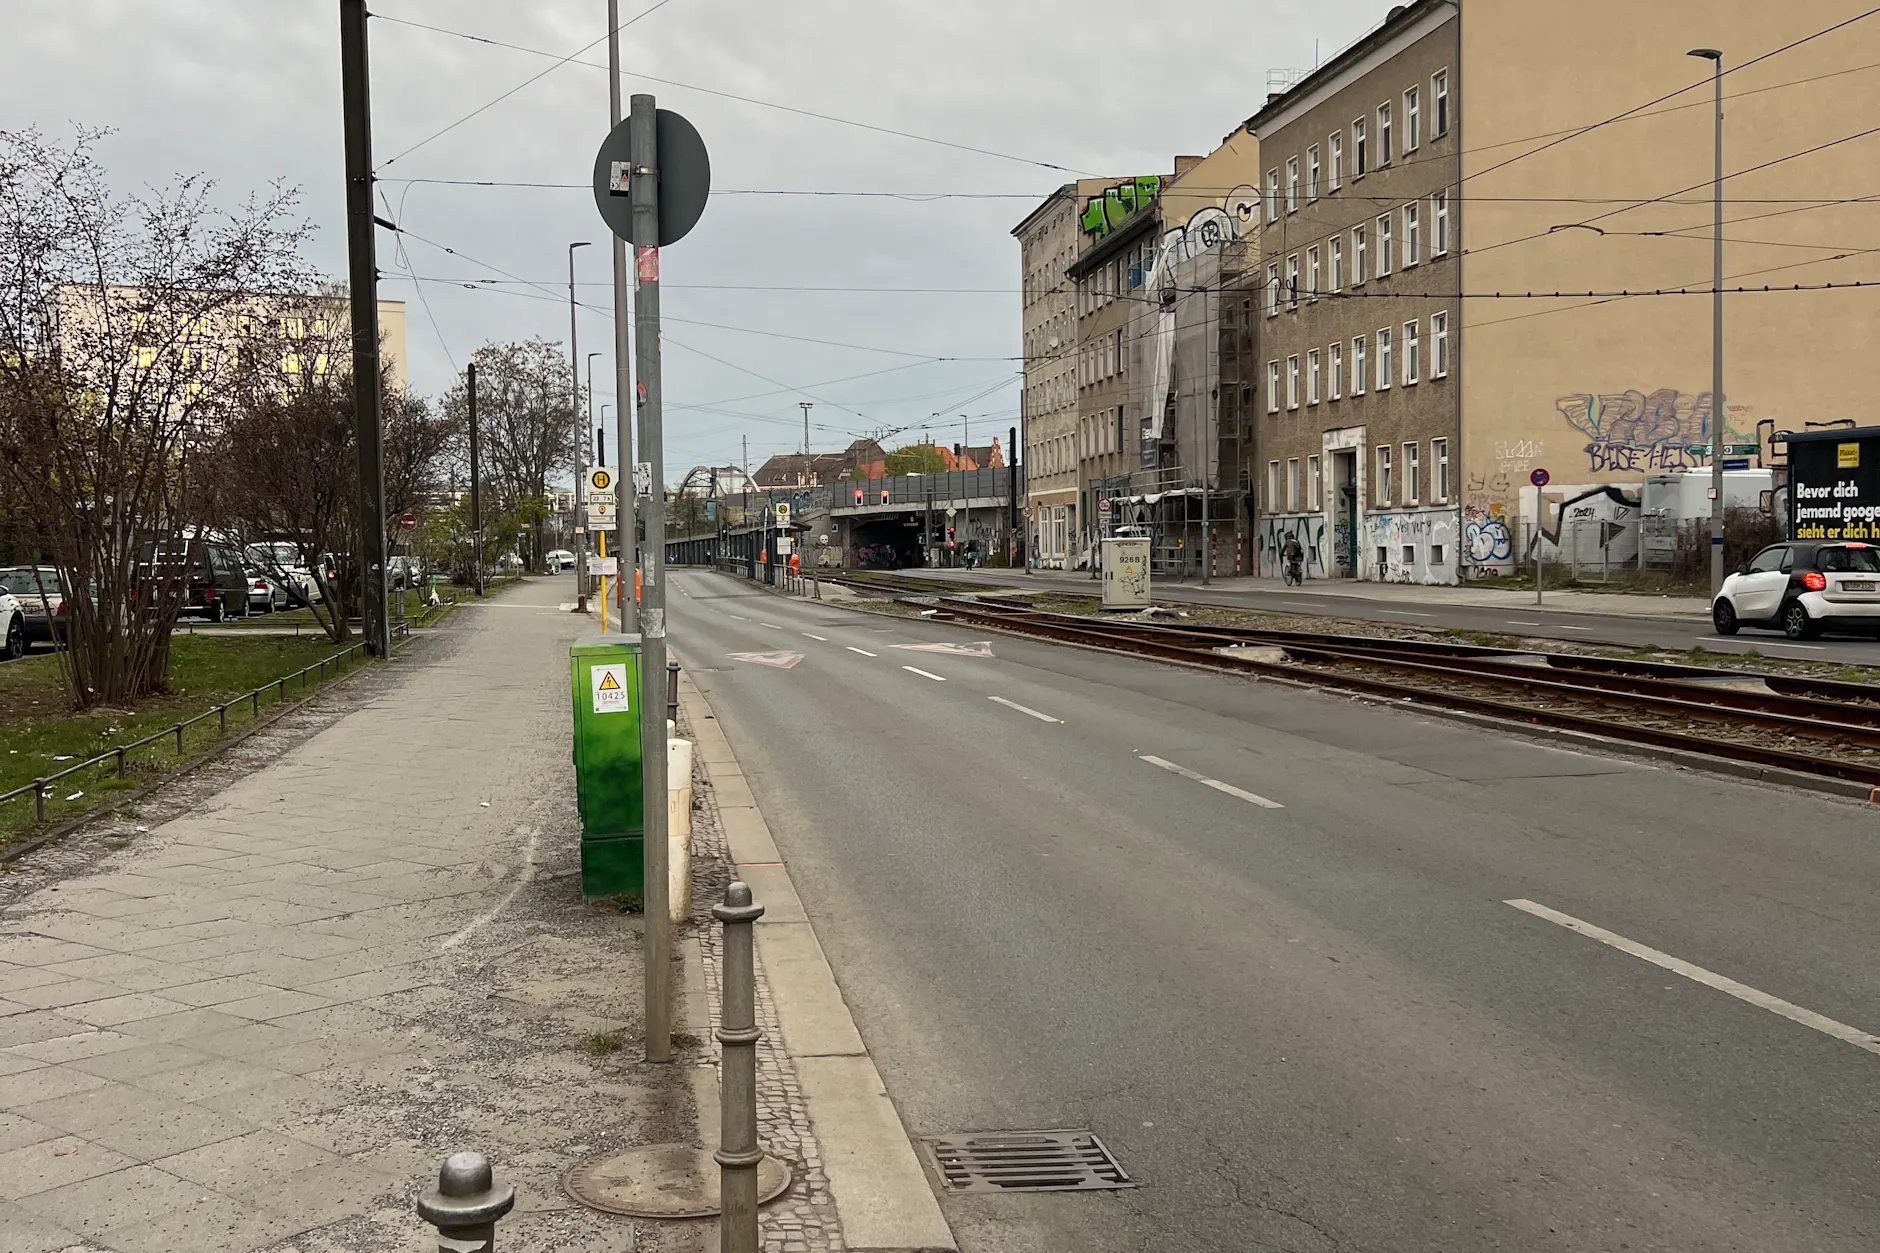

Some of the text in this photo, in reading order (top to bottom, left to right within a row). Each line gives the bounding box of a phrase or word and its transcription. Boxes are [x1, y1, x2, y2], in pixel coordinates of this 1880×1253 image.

[597, 475, 605, 485] H
[1796, 480, 1859, 499] Bevor dich
[1796, 501, 1841, 523] jemand
[1797, 522, 1825, 539] sieht
[1827, 527, 1840, 539] er
[1843, 522, 1868, 539] dich
[596, 691, 625, 701] 10425
